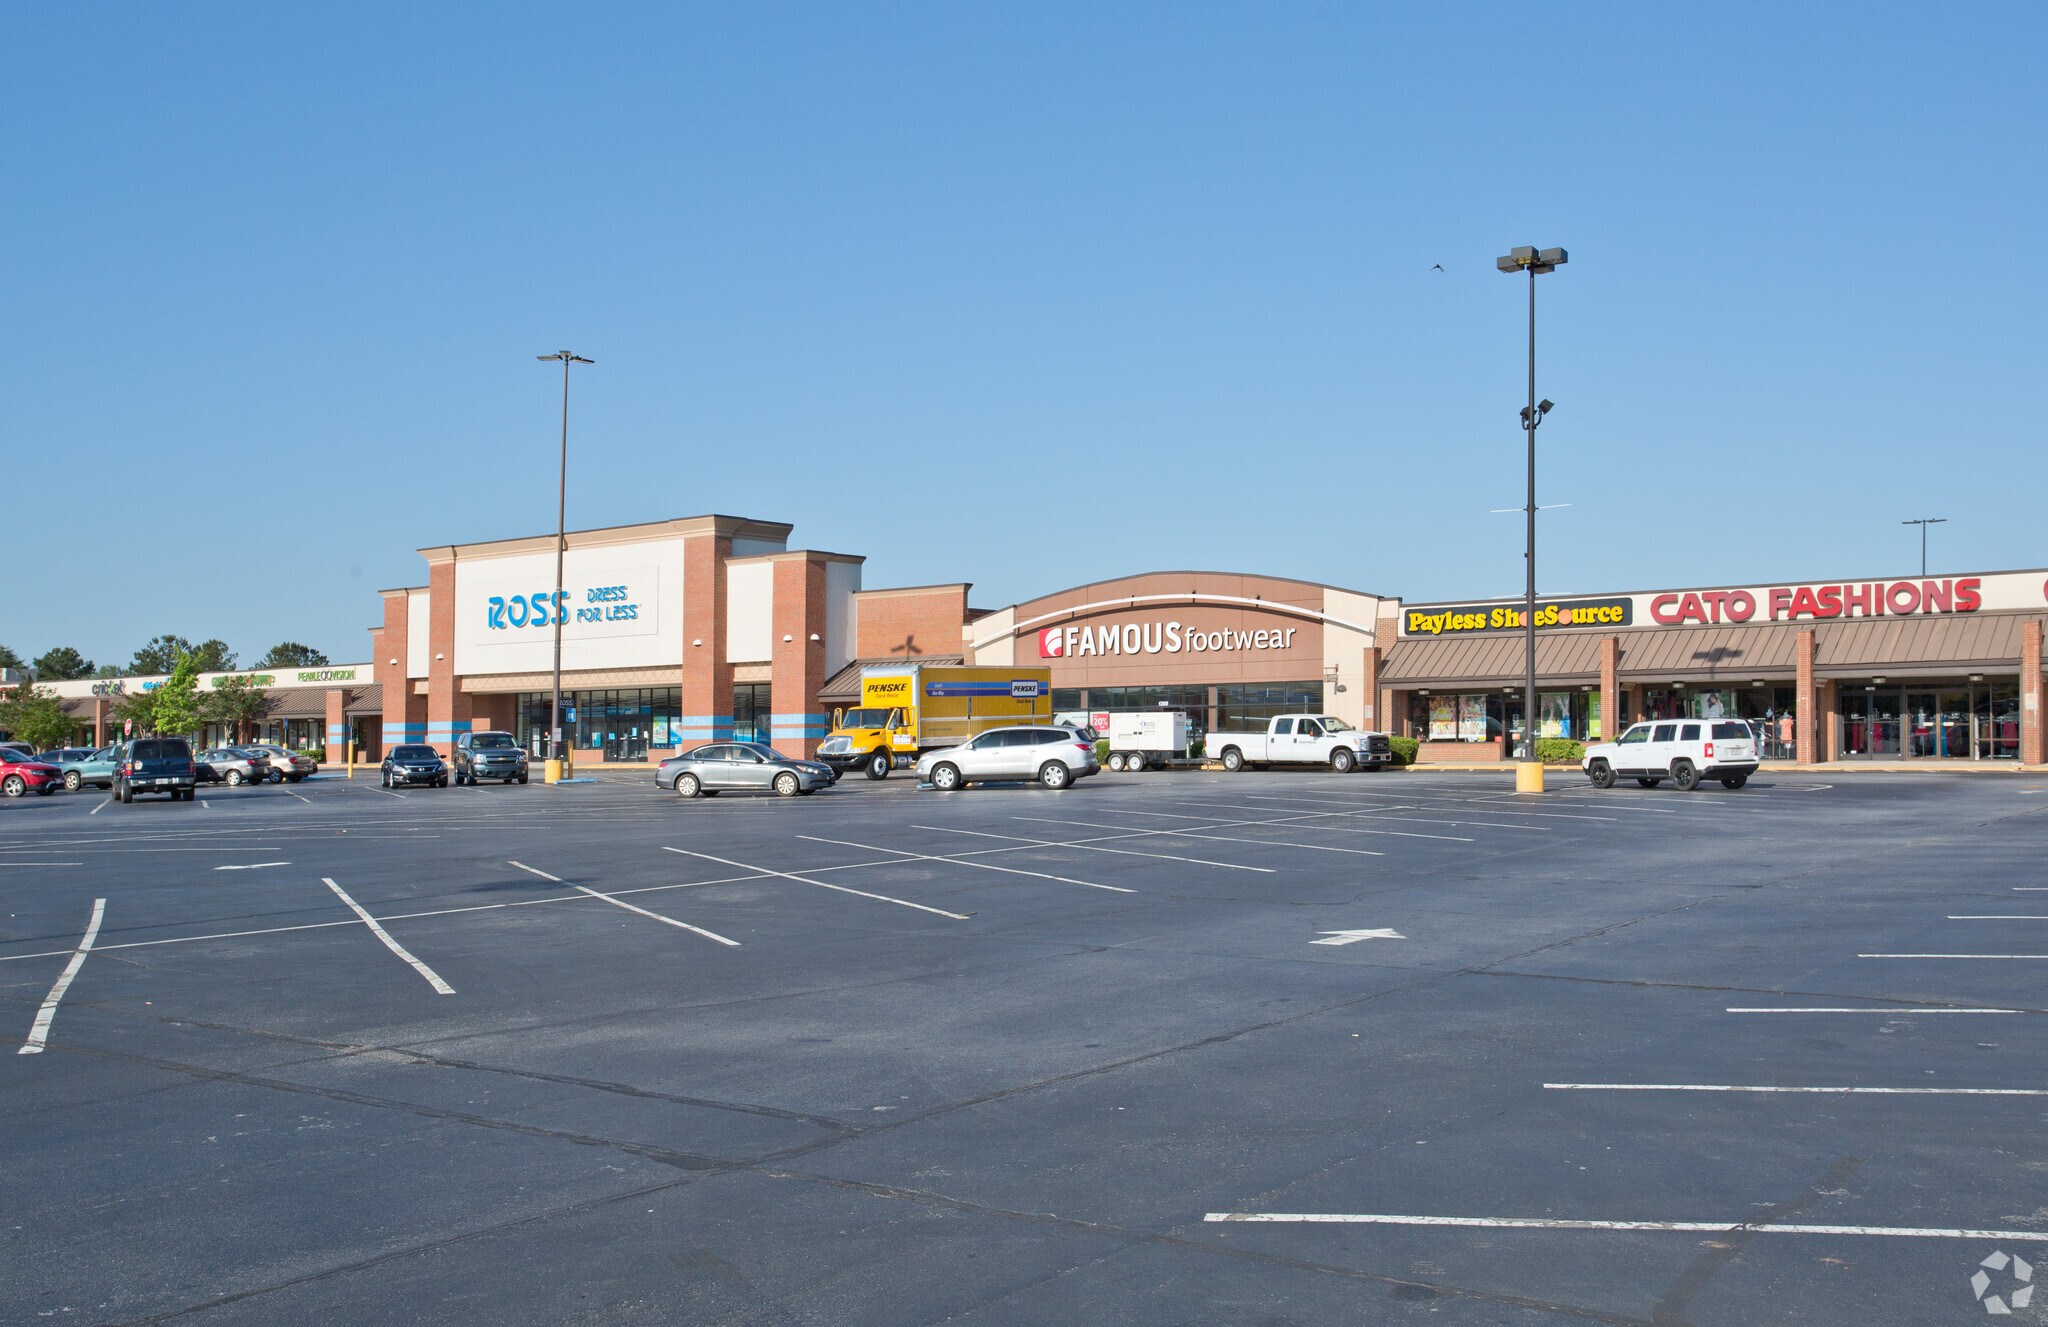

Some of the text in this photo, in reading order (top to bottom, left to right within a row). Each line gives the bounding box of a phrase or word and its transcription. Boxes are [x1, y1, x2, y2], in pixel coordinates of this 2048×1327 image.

[587, 585, 628, 603] DRESS
[1650, 577, 1981, 625] CATO FASHIONS
[488, 590, 570, 629] ROSS
[576, 604, 639, 623] FOR LESS
[1408, 605, 1624, 635] Payless ShoeSource
[1065, 621, 1296, 657] FAMOUS footwear
[298, 669, 355, 681] PEARLE VISION
[867, 683, 907, 693] PENSKE
[1093, 717, 1108, 726] 20%
